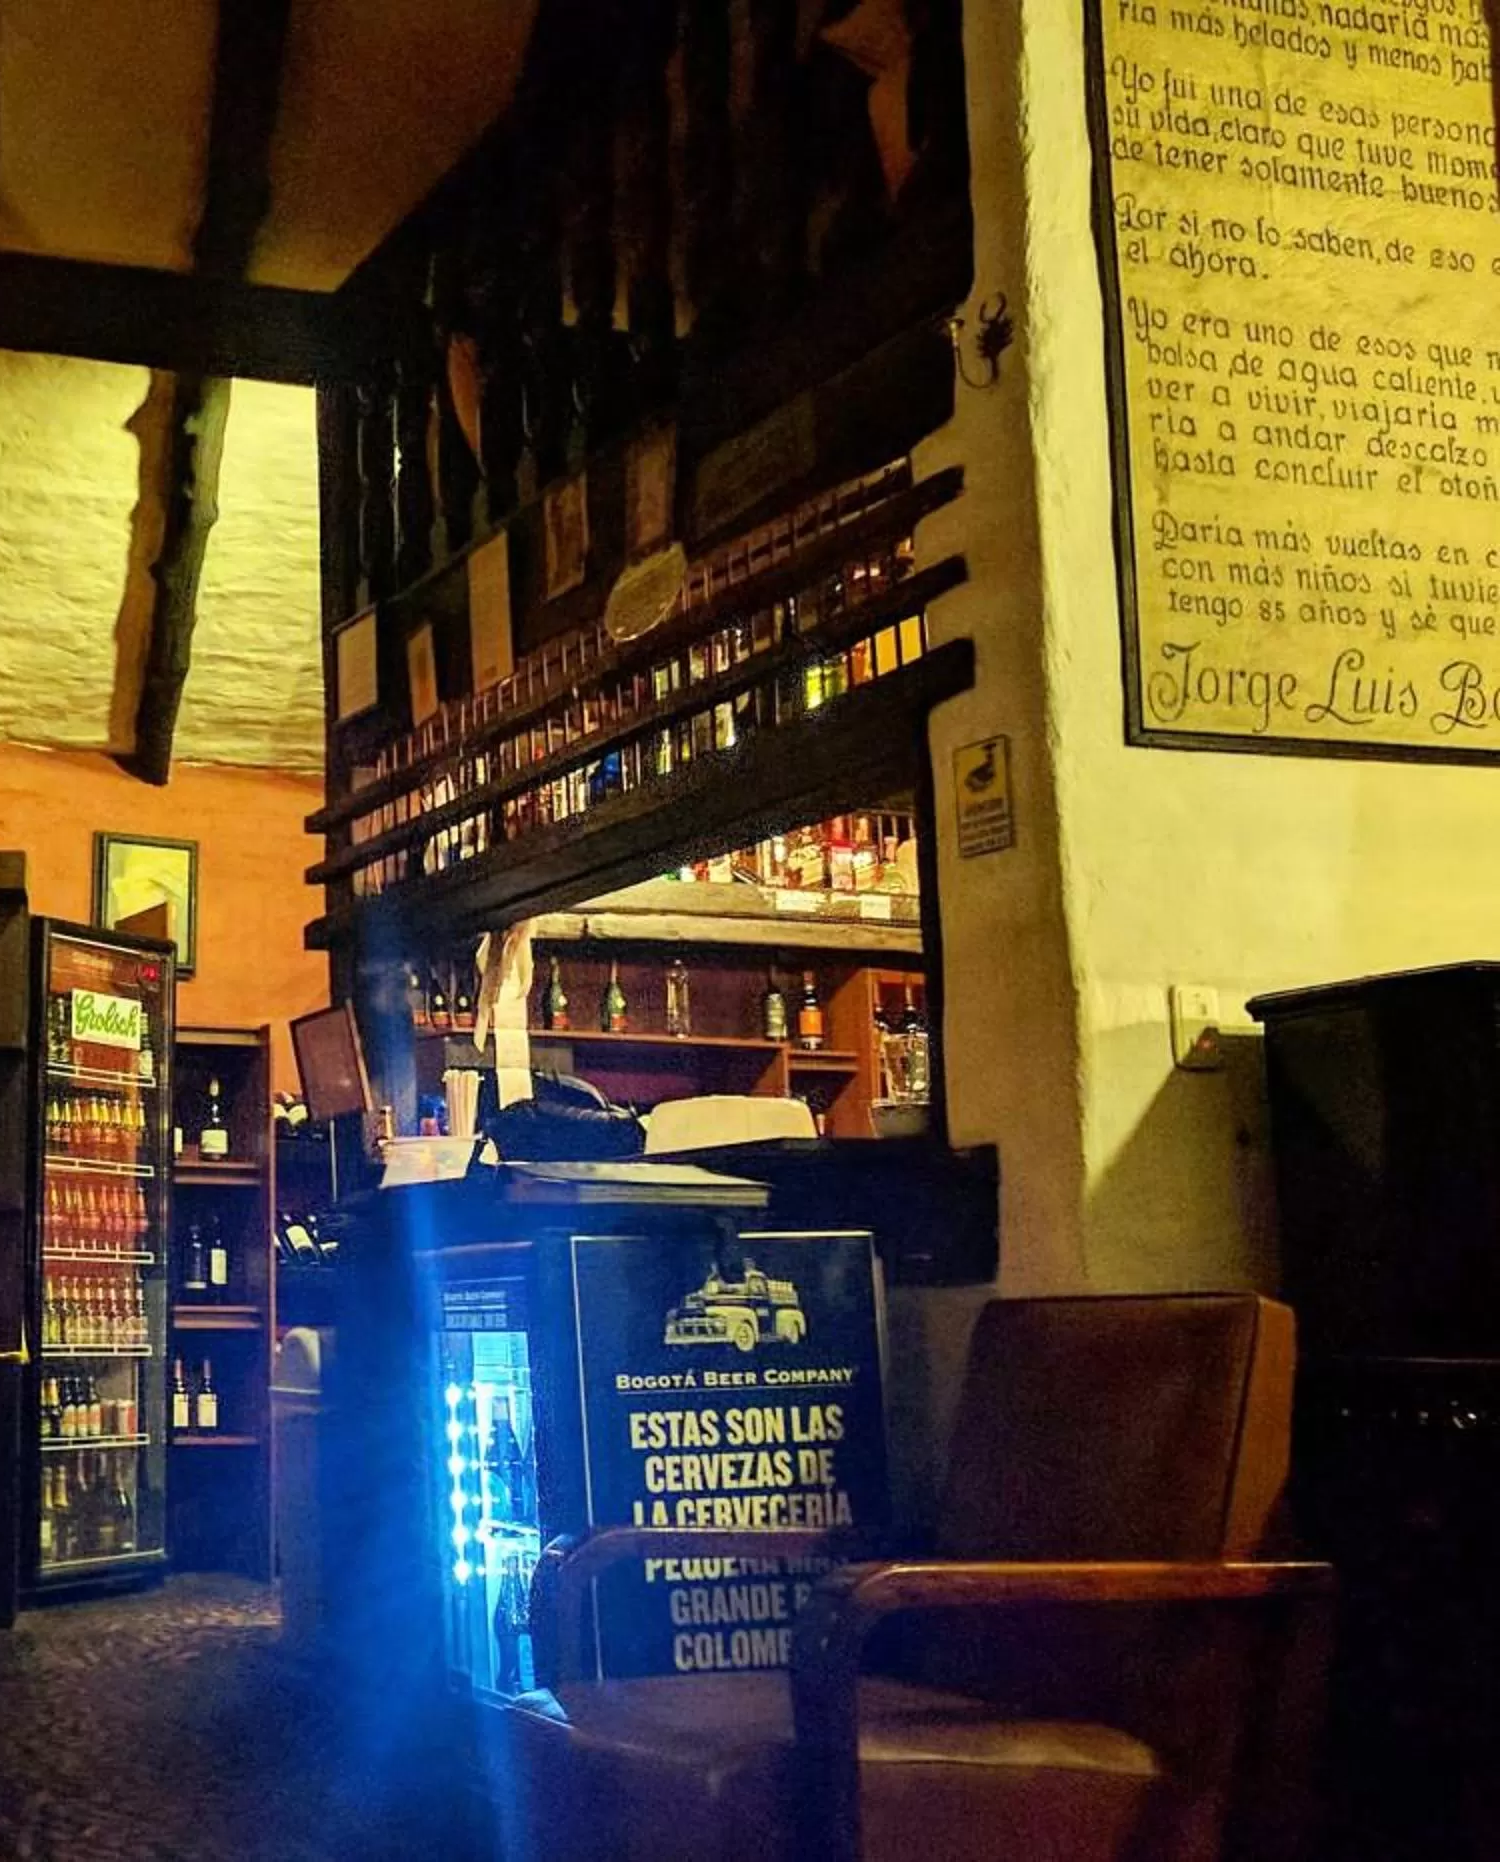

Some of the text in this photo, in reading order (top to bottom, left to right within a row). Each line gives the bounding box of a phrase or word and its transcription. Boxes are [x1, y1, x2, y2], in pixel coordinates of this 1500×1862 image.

[1170, 6, 1225, 37] más
[1233, 13, 1331, 58] helados
[1344, 40, 1357, 70] y
[1368, 43, 1441, 76] menos
[1111, 55, 1155, 105] Yo
[1164, 67, 1197, 112] fui
[1211, 83, 1261, 111] una
[1275, 88, 1307, 116] de
[1320, 102, 1380, 129] esas
[1112, 104, 1140, 129] su
[1220, 118, 1286, 149] claro
[1299, 133, 1346, 163] que
[1356, 137, 1415, 170] tuve
[1112, 135, 1143, 161] de
[1154, 140, 1228, 174] tener
[1240, 155, 1384, 198] solamente
[1125, 237, 1270, 279] el ahora.
[1179, 210, 1200, 237] si
[1211, 218, 1246, 243] no
[1255, 216, 1281, 247] lo
[1385, 238, 1415, 264] de
[1429, 248, 1475, 273] eso
[1127, 296, 1168, 343] Yo
[1183, 313, 1230, 339] era
[1244, 322, 1293, 348] uno
[1309, 325, 1341, 352] de
[1356, 335, 1417, 361] esos
[1428, 343, 1473, 371] que
[1147, 377, 1195, 401] ver
[1212, 385, 1231, 407] a
[1278, 358, 1357, 394] agua
[1153, 436, 1236, 477] hasta
[1255, 456, 1378, 491] concluir
[1397, 465, 1423, 494] el
[1218, 420, 1237, 442] a
[1253, 423, 1346, 452] andar
[1366, 434, 1487, 468] descalzo
[1253, 519, 1312, 553] más
[1325, 528, 1422, 562] vueltas
[1438, 545, 1469, 566] en
[1162, 557, 1215, 583] con
[1228, 556, 1284, 588] más
[1297, 563, 1371, 593] niños
[1388, 569, 1412, 598] si
[1168, 588, 1244, 627] tengo
[1259, 600, 1286, 622] 85
[1299, 598, 1367, 626] años
[1380, 608, 1396, 639] y
[1451, 614, 1495, 640] que
[1148, 640, 1297, 733] Jorge
[1305, 648, 1417, 724] Luis
[75, 994, 139, 1038] Grolsch
[630, 1404, 844, 1449] ESTAS SON LAS
[645, 1449, 836, 1493] CERVEZAS DE
[671, 1584, 788, 1624] GRANDE
